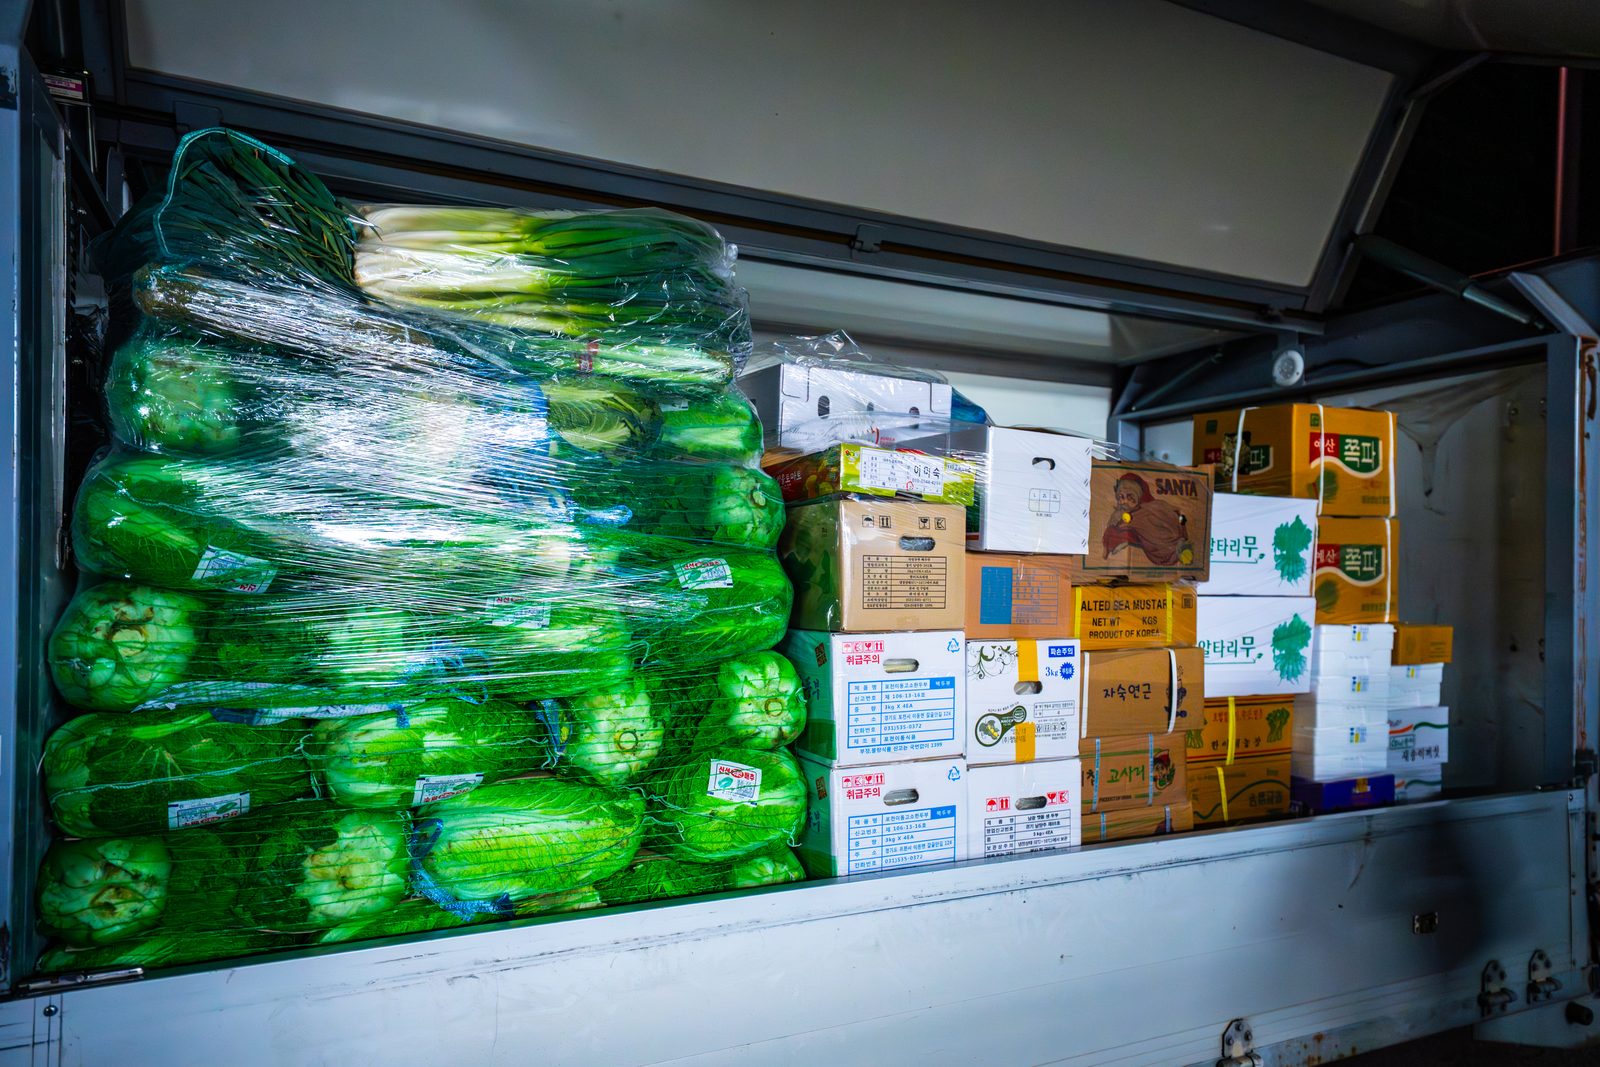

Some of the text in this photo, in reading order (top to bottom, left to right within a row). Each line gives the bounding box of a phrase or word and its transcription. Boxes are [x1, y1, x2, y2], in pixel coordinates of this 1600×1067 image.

[1344, 438, 1377, 468] 쪽파
[1155, 477, 1198, 497] SANTA
[1344, 548, 1378, 577] 쪽파
[1081, 600, 1110, 612] ALTED
[1113, 599, 1130, 611] SEA
[1132, 598, 1174, 611] MUSTAR
[1092, 616, 1158, 627] NET WT KGS
[1089, 629, 1160, 639] PRODUCT OF KOREA
[1050, 647, 1074, 656] 파손주의
[1198, 636, 1256, 660] 알타리무
[846, 654, 880, 665] 취급주의
[1045, 666, 1059, 678] 3kg
[1103, 683, 1152, 701] 자숙연근
[1106, 763, 1145, 785] 고사리
[846, 787, 881, 800] 취급주의
